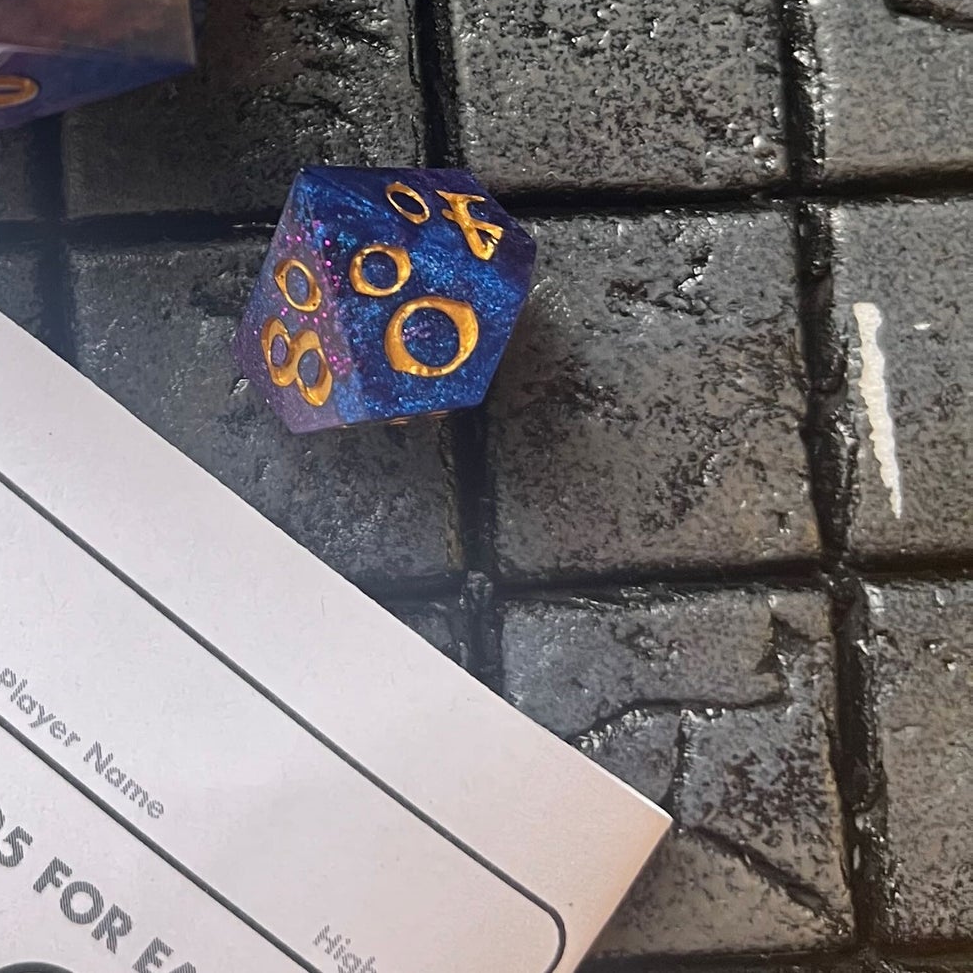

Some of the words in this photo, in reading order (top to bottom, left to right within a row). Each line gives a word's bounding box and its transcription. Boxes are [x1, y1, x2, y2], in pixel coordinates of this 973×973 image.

[83, 740, 165, 820] Name
[32, 856, 133, 955] FOR
[132, 936, 197, 973] E
